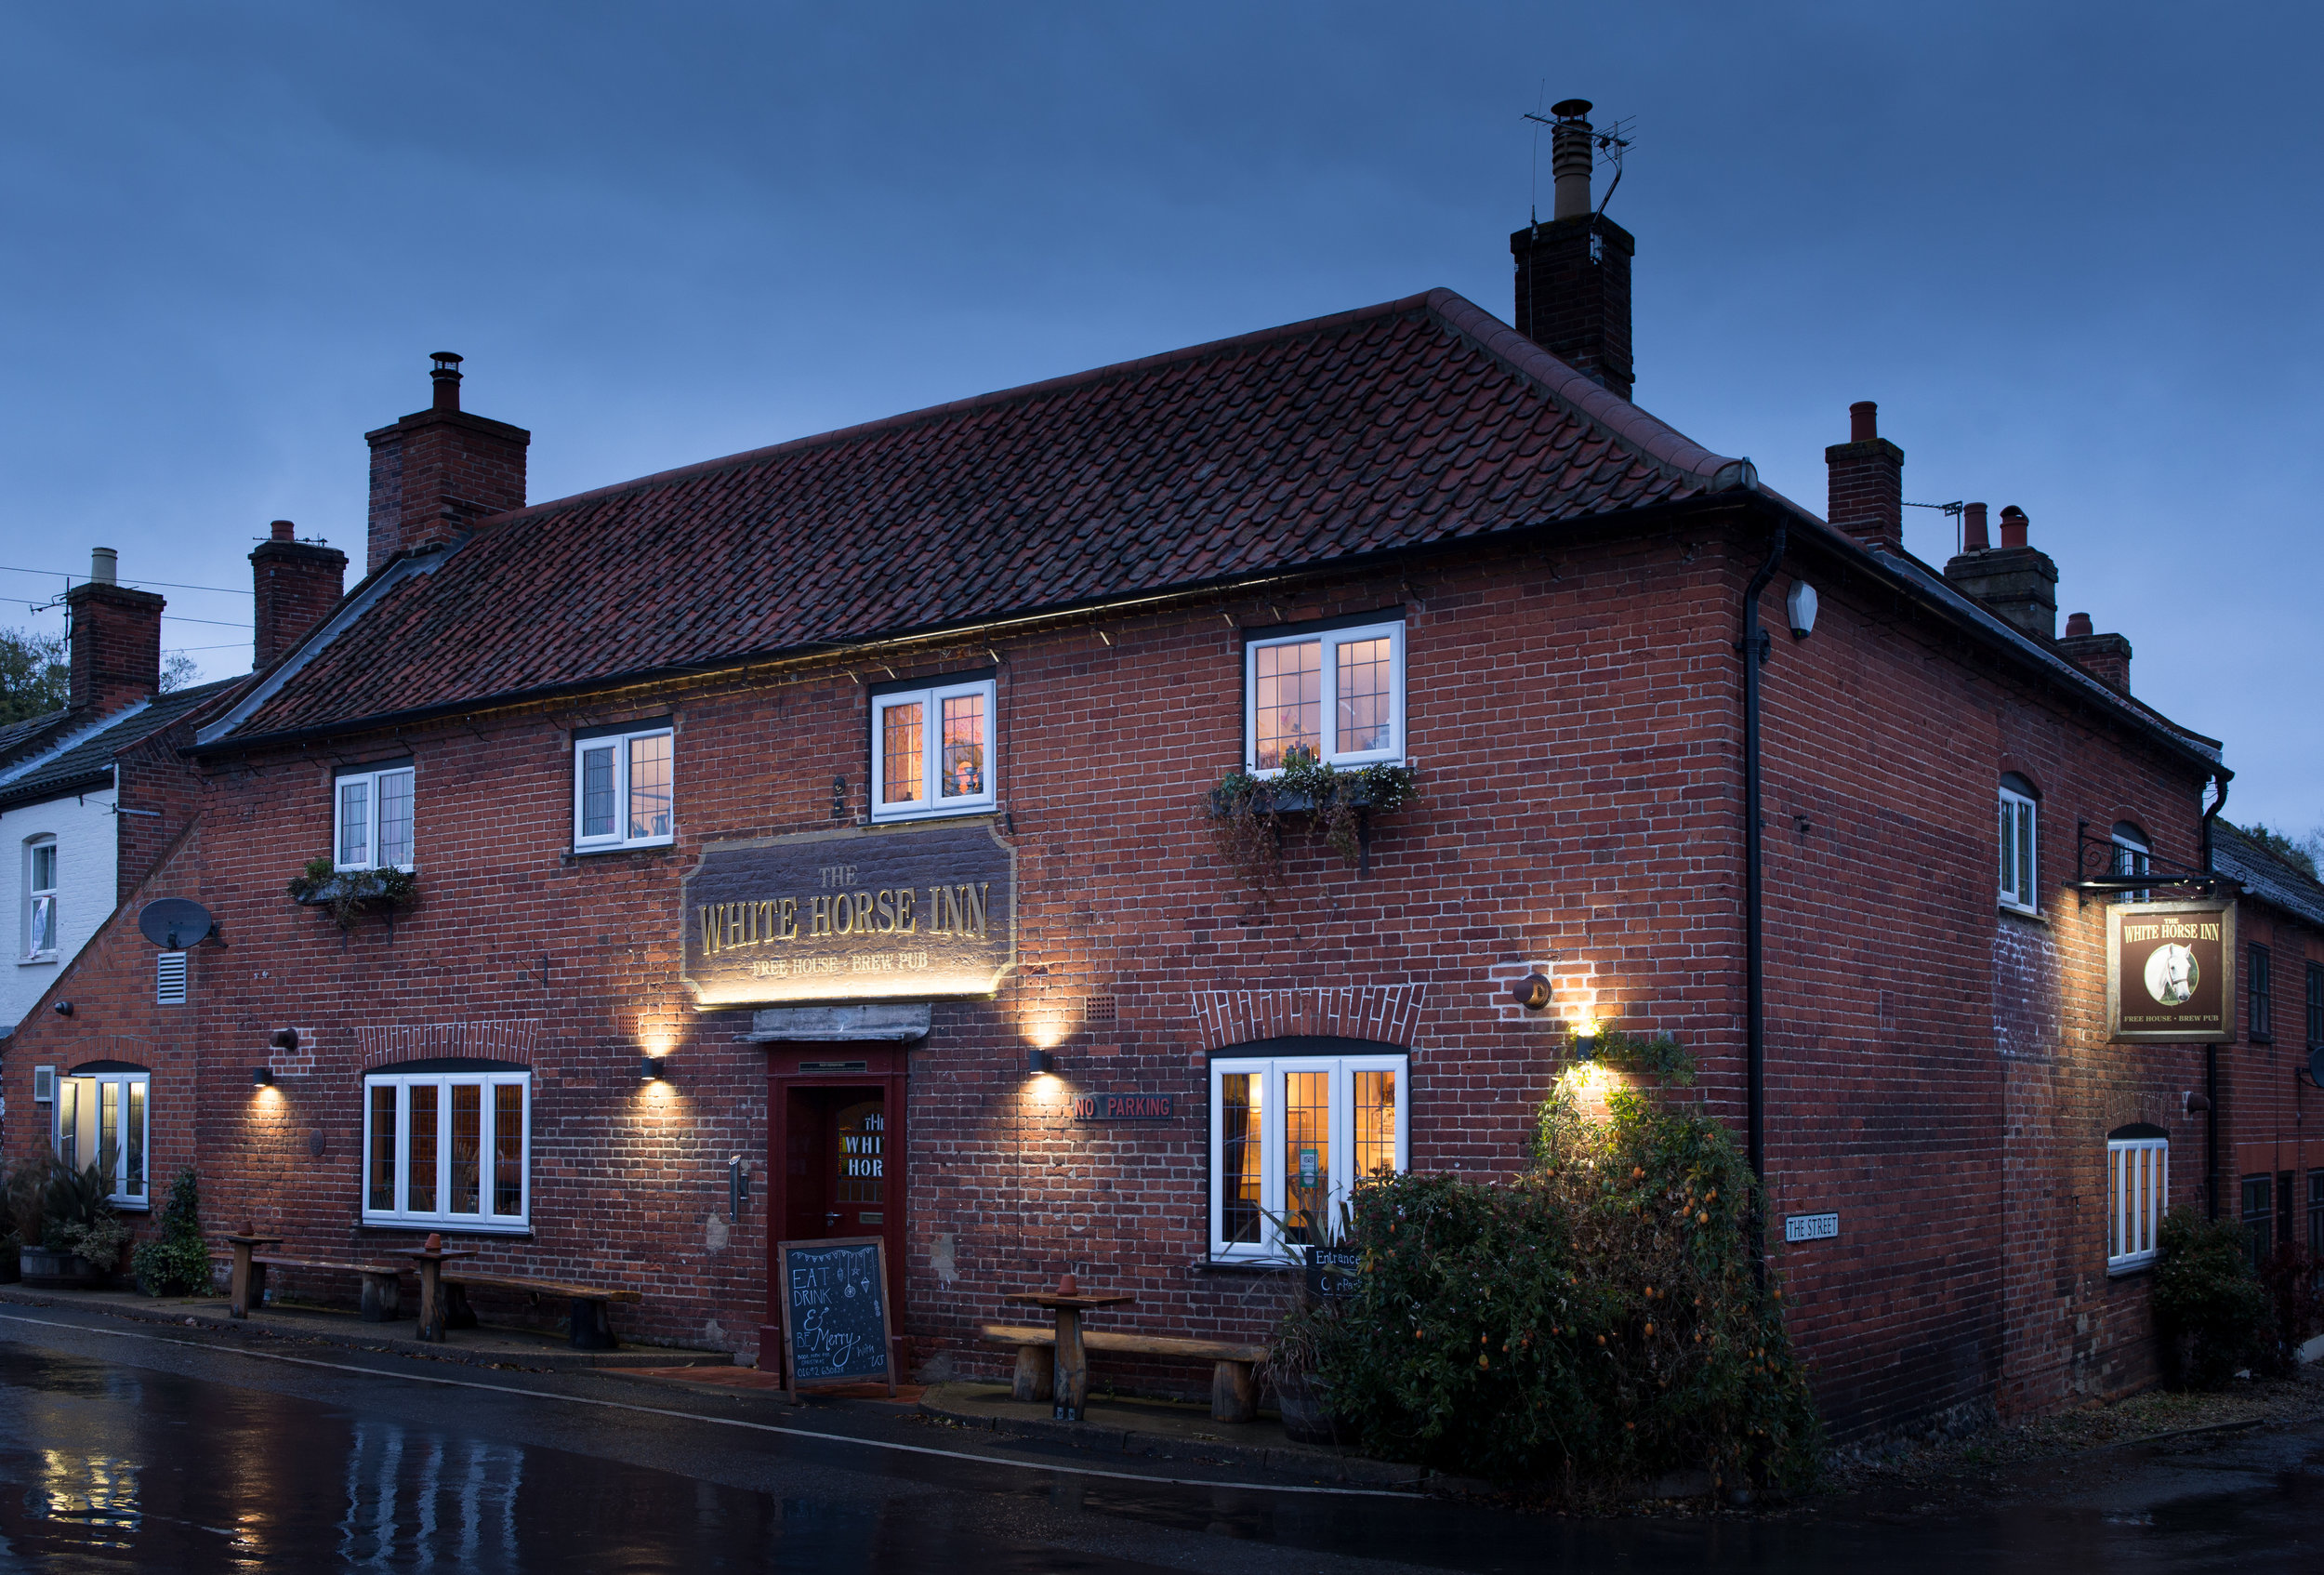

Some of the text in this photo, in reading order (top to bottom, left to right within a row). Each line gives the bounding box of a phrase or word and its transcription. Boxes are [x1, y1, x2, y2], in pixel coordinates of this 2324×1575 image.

[818, 865, 858, 888] THE
[698, 881, 989, 956] WHITE HORSE INN
[2123, 923, 2220, 944] WHITE HORSE INN
[752, 952, 928, 976] FREE HOUSE BREW PUB
[1074, 1097, 1169, 1117] NO PARKING
[845, 1136, 884, 1154] WHI
[1788, 1217, 1837, 1238] THE STREET
[1315, 1250, 1361, 1264] Entrance
[793, 1267, 830, 1289] EAT
[794, 1287, 832, 1306] DRINK
[797, 1328, 861, 1368] BE Merry
